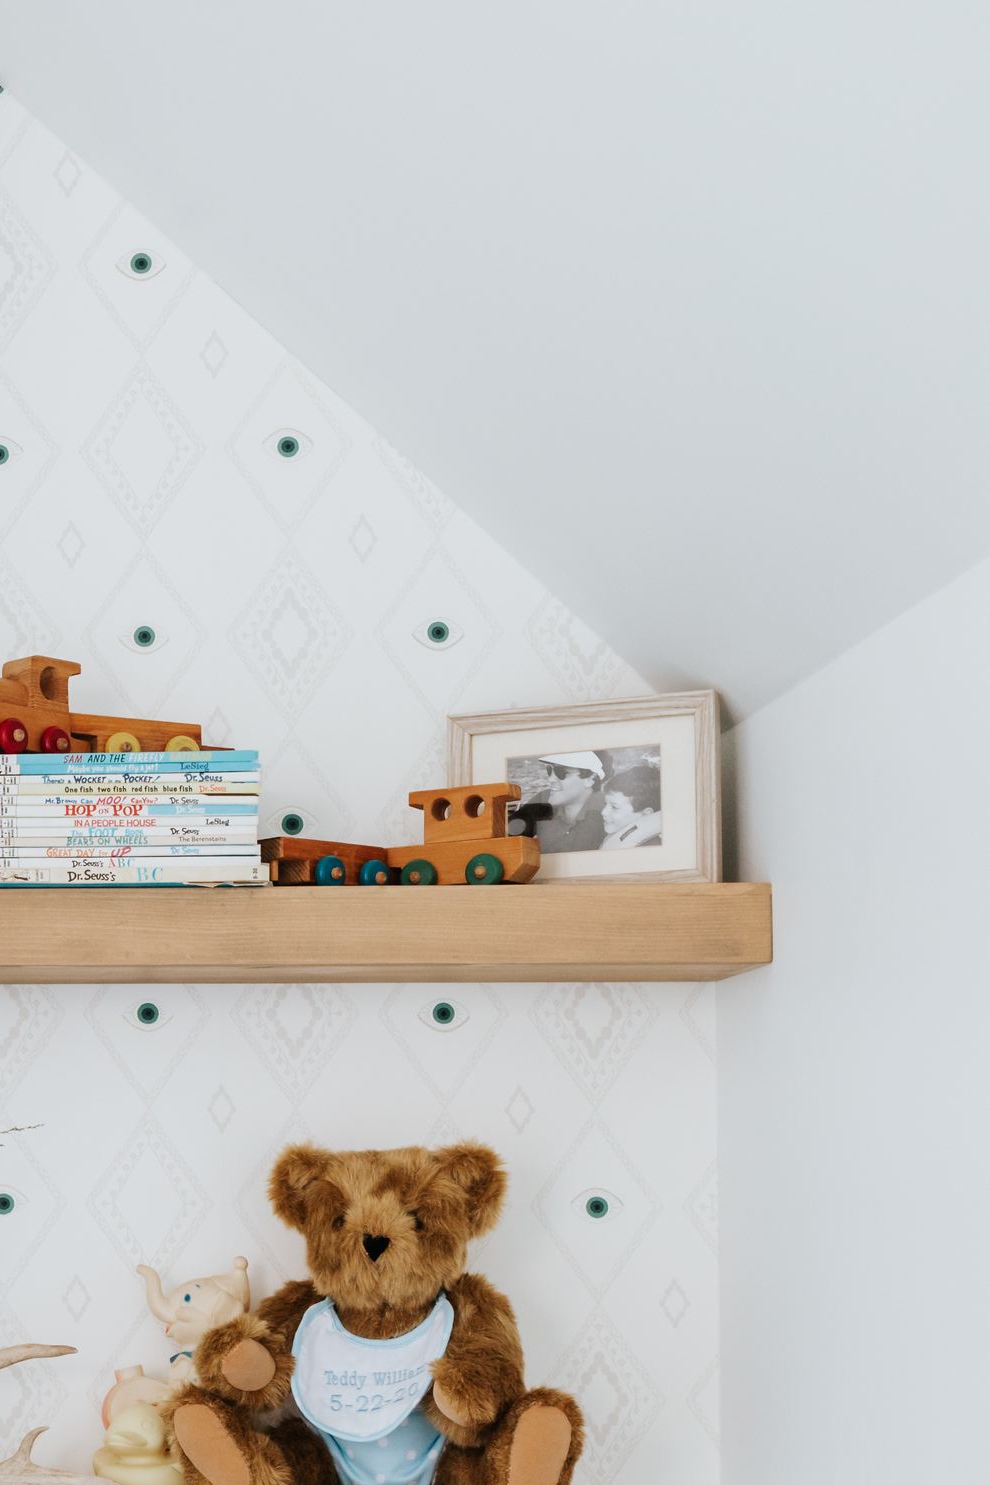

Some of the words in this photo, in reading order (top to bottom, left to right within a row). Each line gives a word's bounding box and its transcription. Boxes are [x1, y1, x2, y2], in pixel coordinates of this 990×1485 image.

[64, 755, 82, 764] SAM
[88, 754, 106, 763] AND
[109, 754, 126, 762] THE
[180, 762, 210, 772] LeSieg
[74, 775, 106, 784] WOCKET
[184, 774, 197, 782] Dr.
[199, 772, 223, 782] Seuss
[210, 784, 227, 792] Seuss
[96, 796, 126, 805] MOO!
[181, 797, 199, 805] Seuss
[64, 804, 97, 816] HOP
[112, 804, 143, 816] POP
[92, 819, 124, 827] PEOPLE
[126, 819, 157, 827] HOUSE
[205, 818, 230, 826] LeSieg
[88, 828, 118, 837] FOOT
[66, 837, 94, 846] BEARS
[115, 836, 148, 845] WHEELS
[46, 847, 71, 857] GREAT
[76, 848, 95, 857] DAY
[110, 846, 132, 857] UP
[72, 860, 82, 868] Dr.
[83, 859, 103, 868] Seuss's
[67, 871, 83, 882] Dr.
[84, 869, 116, 882] Seuss's
[324, 1370, 367, 1390] Teddy
